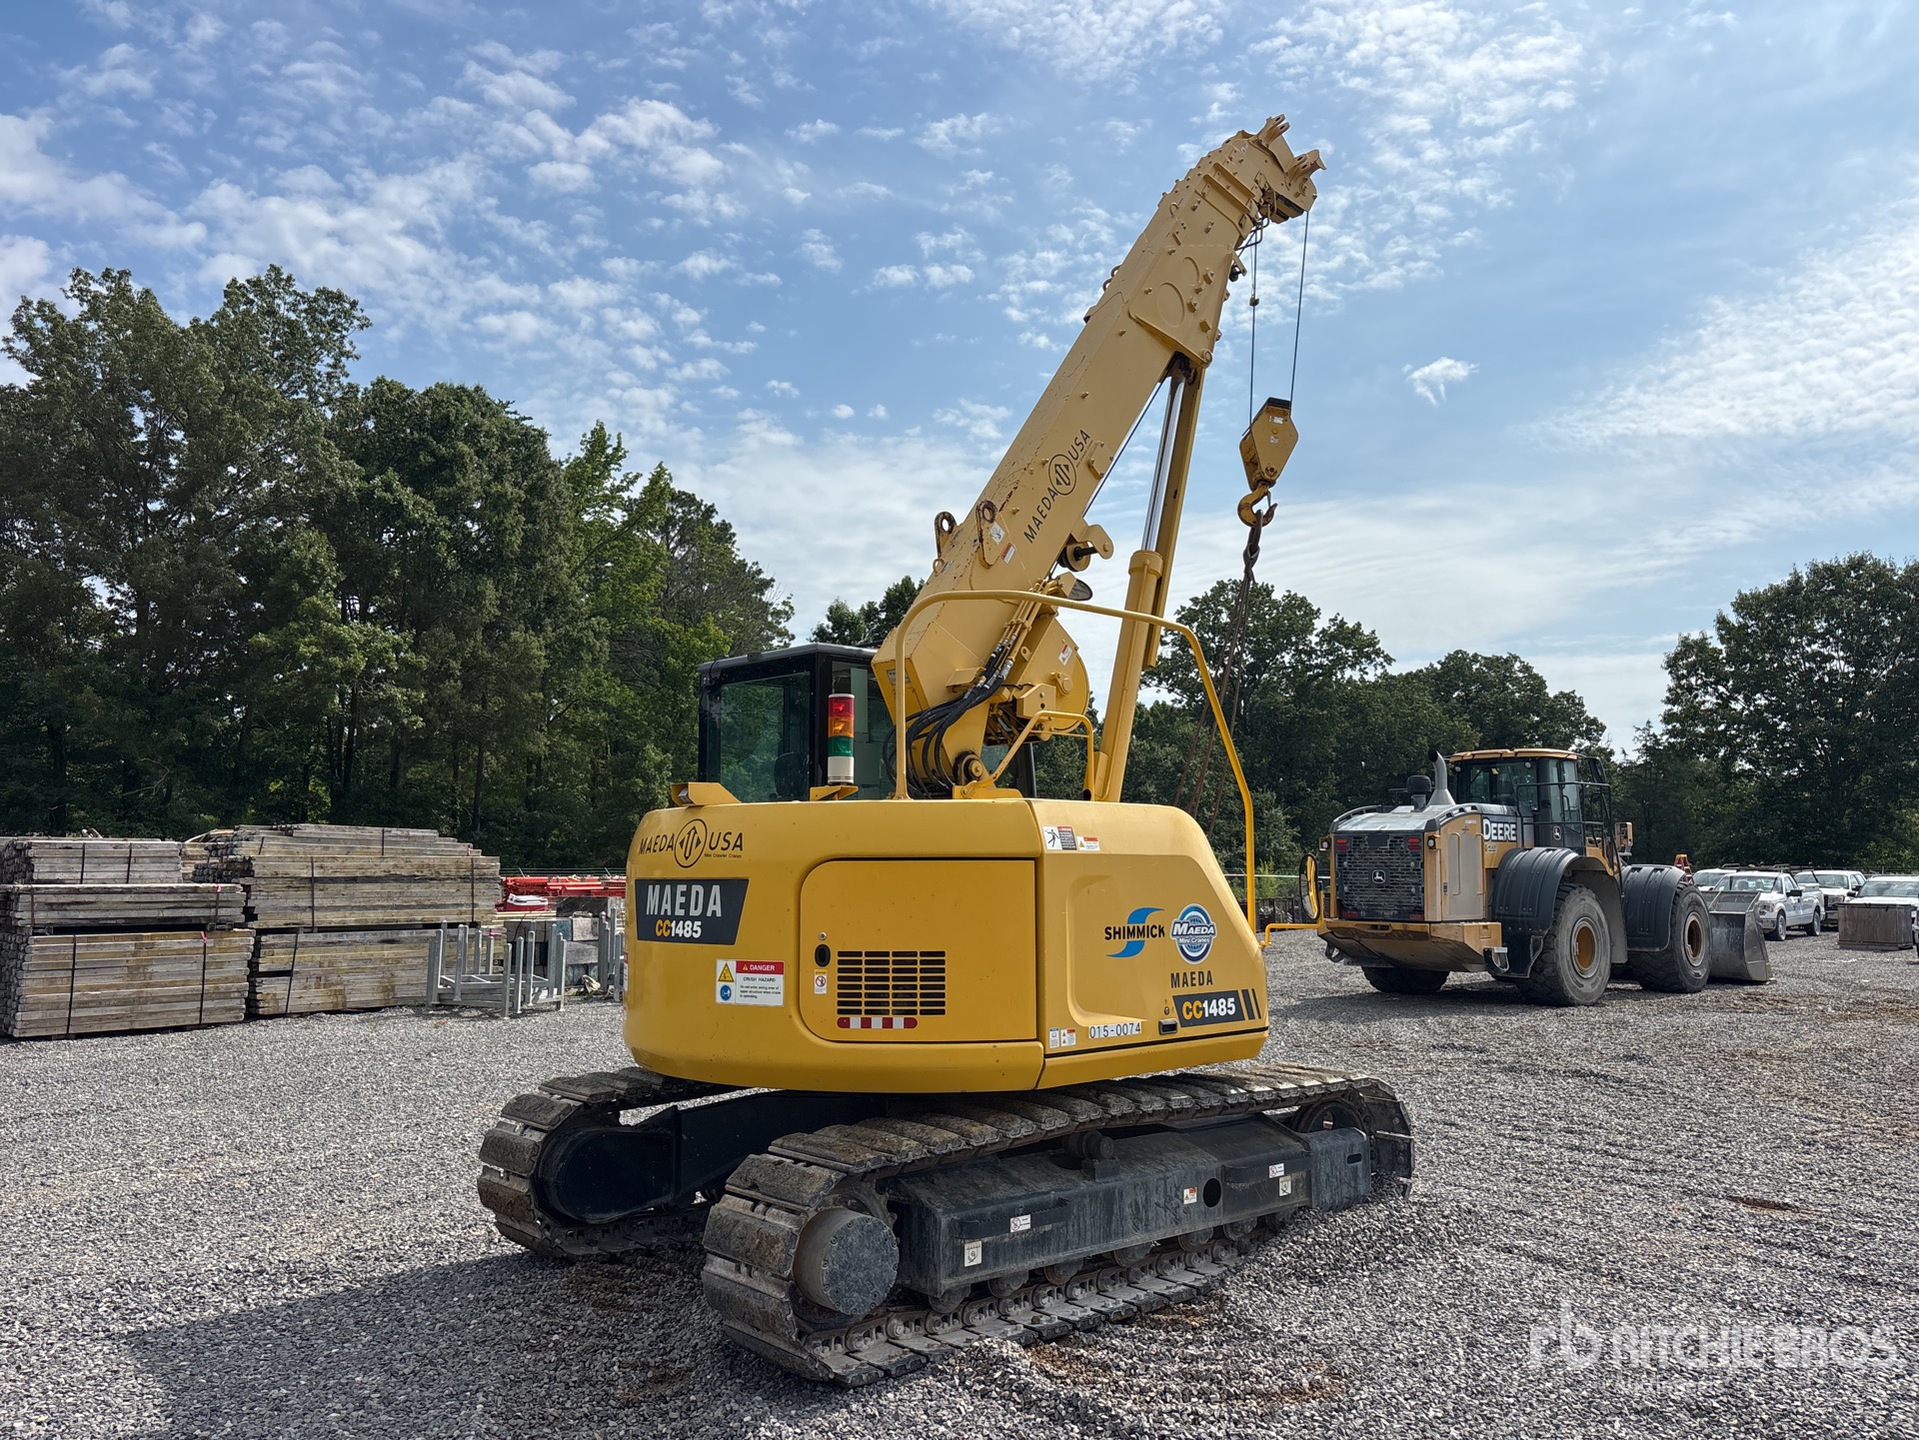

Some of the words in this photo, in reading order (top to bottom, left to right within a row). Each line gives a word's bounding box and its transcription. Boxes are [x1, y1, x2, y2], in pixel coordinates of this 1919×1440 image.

[1023, 487, 1058, 544] MAEDA
[1067, 429, 1091, 461] USA
[1482, 818, 1517, 841] DEERE
[638, 833, 675, 855] MAEDA
[708, 832, 743, 851] USA
[646, 884, 722, 917] MAEDA
[655, 919, 702, 938] CC1485
[1104, 924, 1166, 941] SHIMMICK
[1170, 970, 1213, 989] MAEDA
[1182, 997, 1236, 1020] CC1485
[1089, 1022, 1141, 1039] 015-0074
